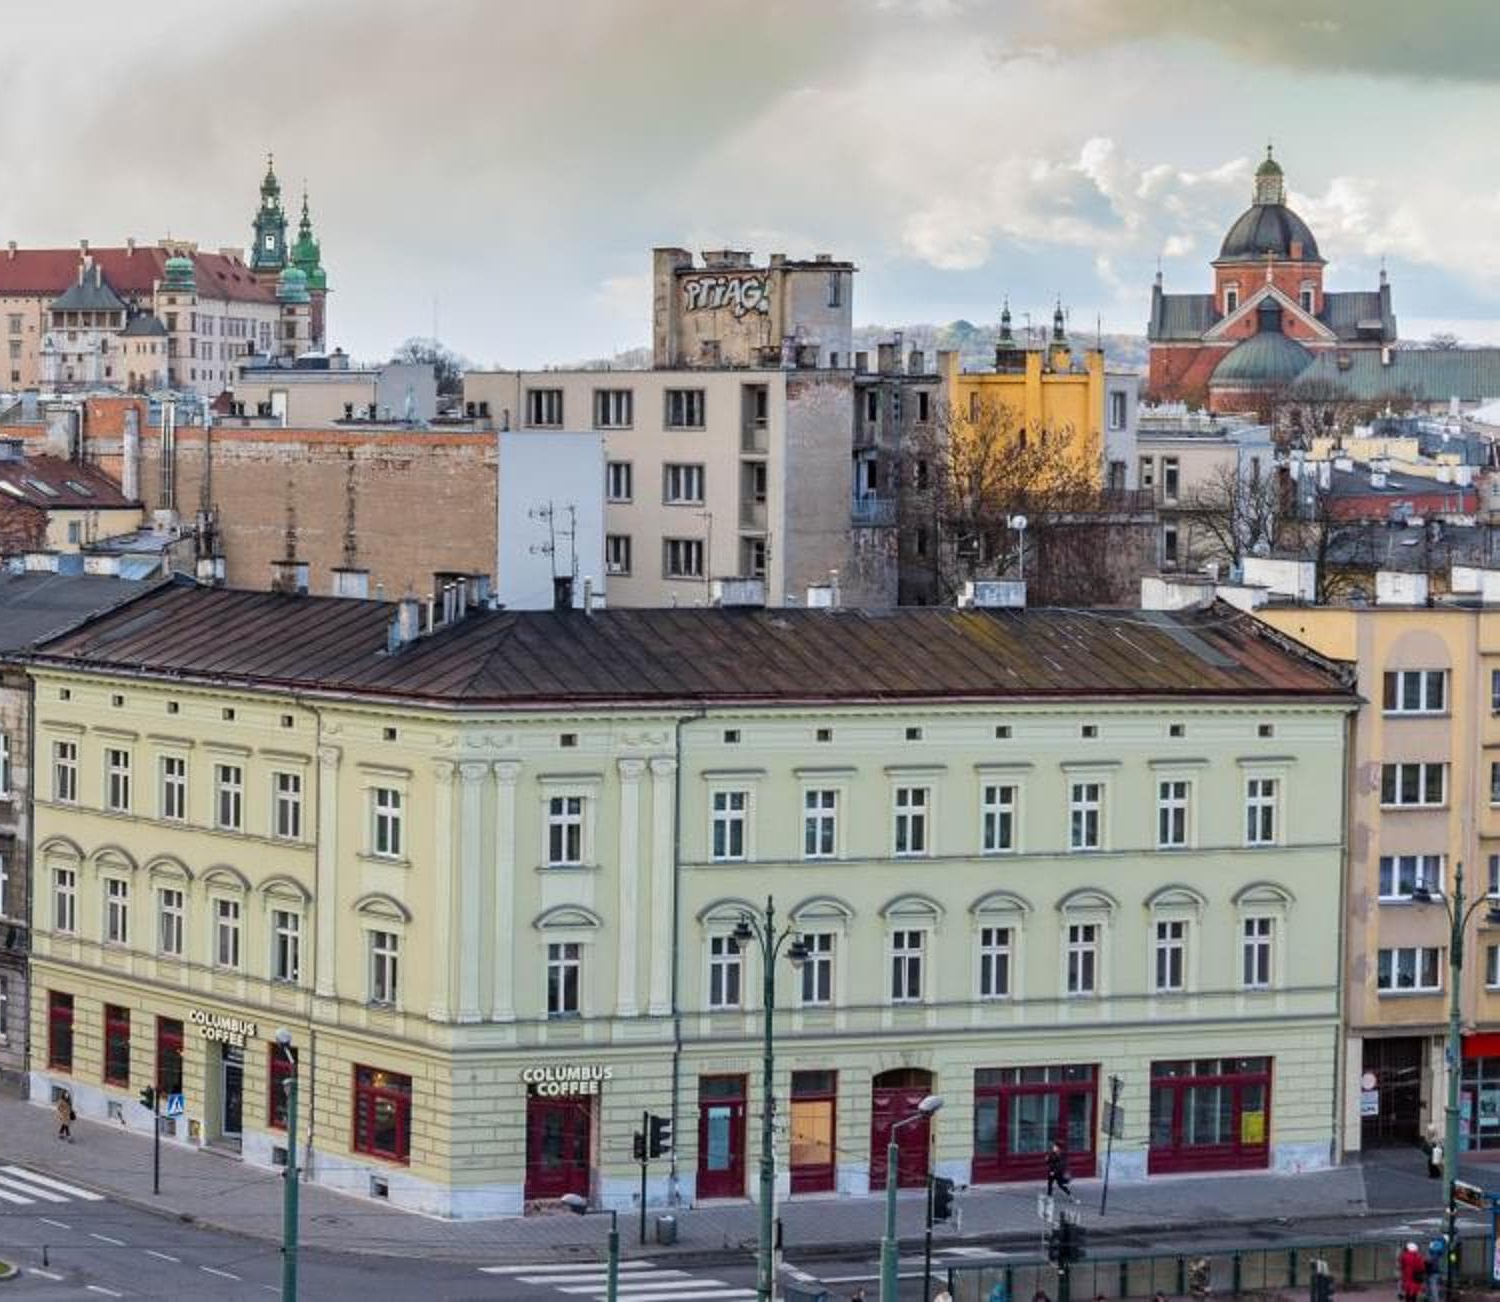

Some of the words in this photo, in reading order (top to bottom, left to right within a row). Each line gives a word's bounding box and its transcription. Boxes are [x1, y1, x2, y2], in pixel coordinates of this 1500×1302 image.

[189, 1009, 255, 1036] COLUMBUS
[200, 1026, 245, 1048] COFFEE
[523, 1066, 612, 1082] COLUMBUS
[537, 1081, 599, 1096] COFFEE
